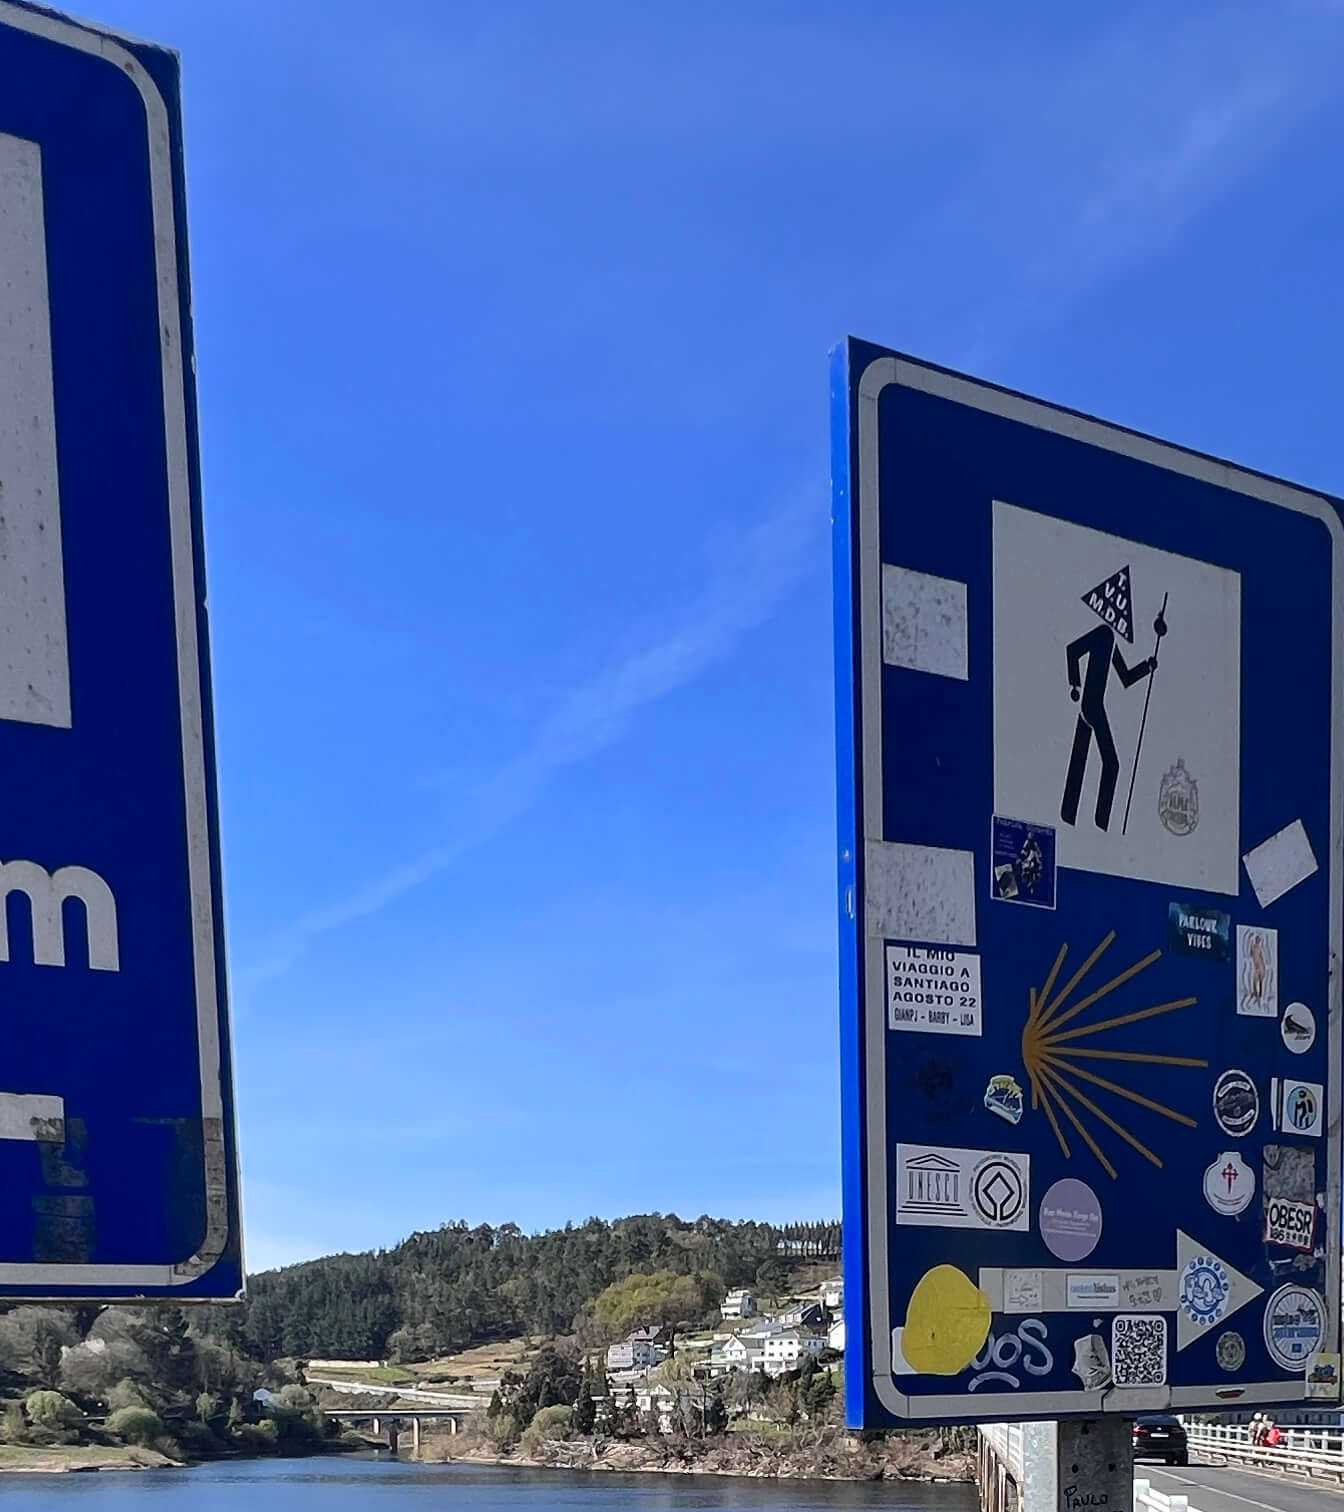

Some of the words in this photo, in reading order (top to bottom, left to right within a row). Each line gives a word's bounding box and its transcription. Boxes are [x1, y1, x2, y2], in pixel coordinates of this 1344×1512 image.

[907, 946, 921, 958] IL
[927, 949, 955, 962] MIO
[893, 961, 955, 977] VIAGGIO
[960, 967, 970, 979] A
[893, 976, 970, 993] SANTIAGO
[893, 991, 954, 1007] AGOSTO
[959, 996, 977, 1008] 22
[908, 1170, 959, 1202] UNESCO
[1269, 1203, 1312, 1235] OBESR
